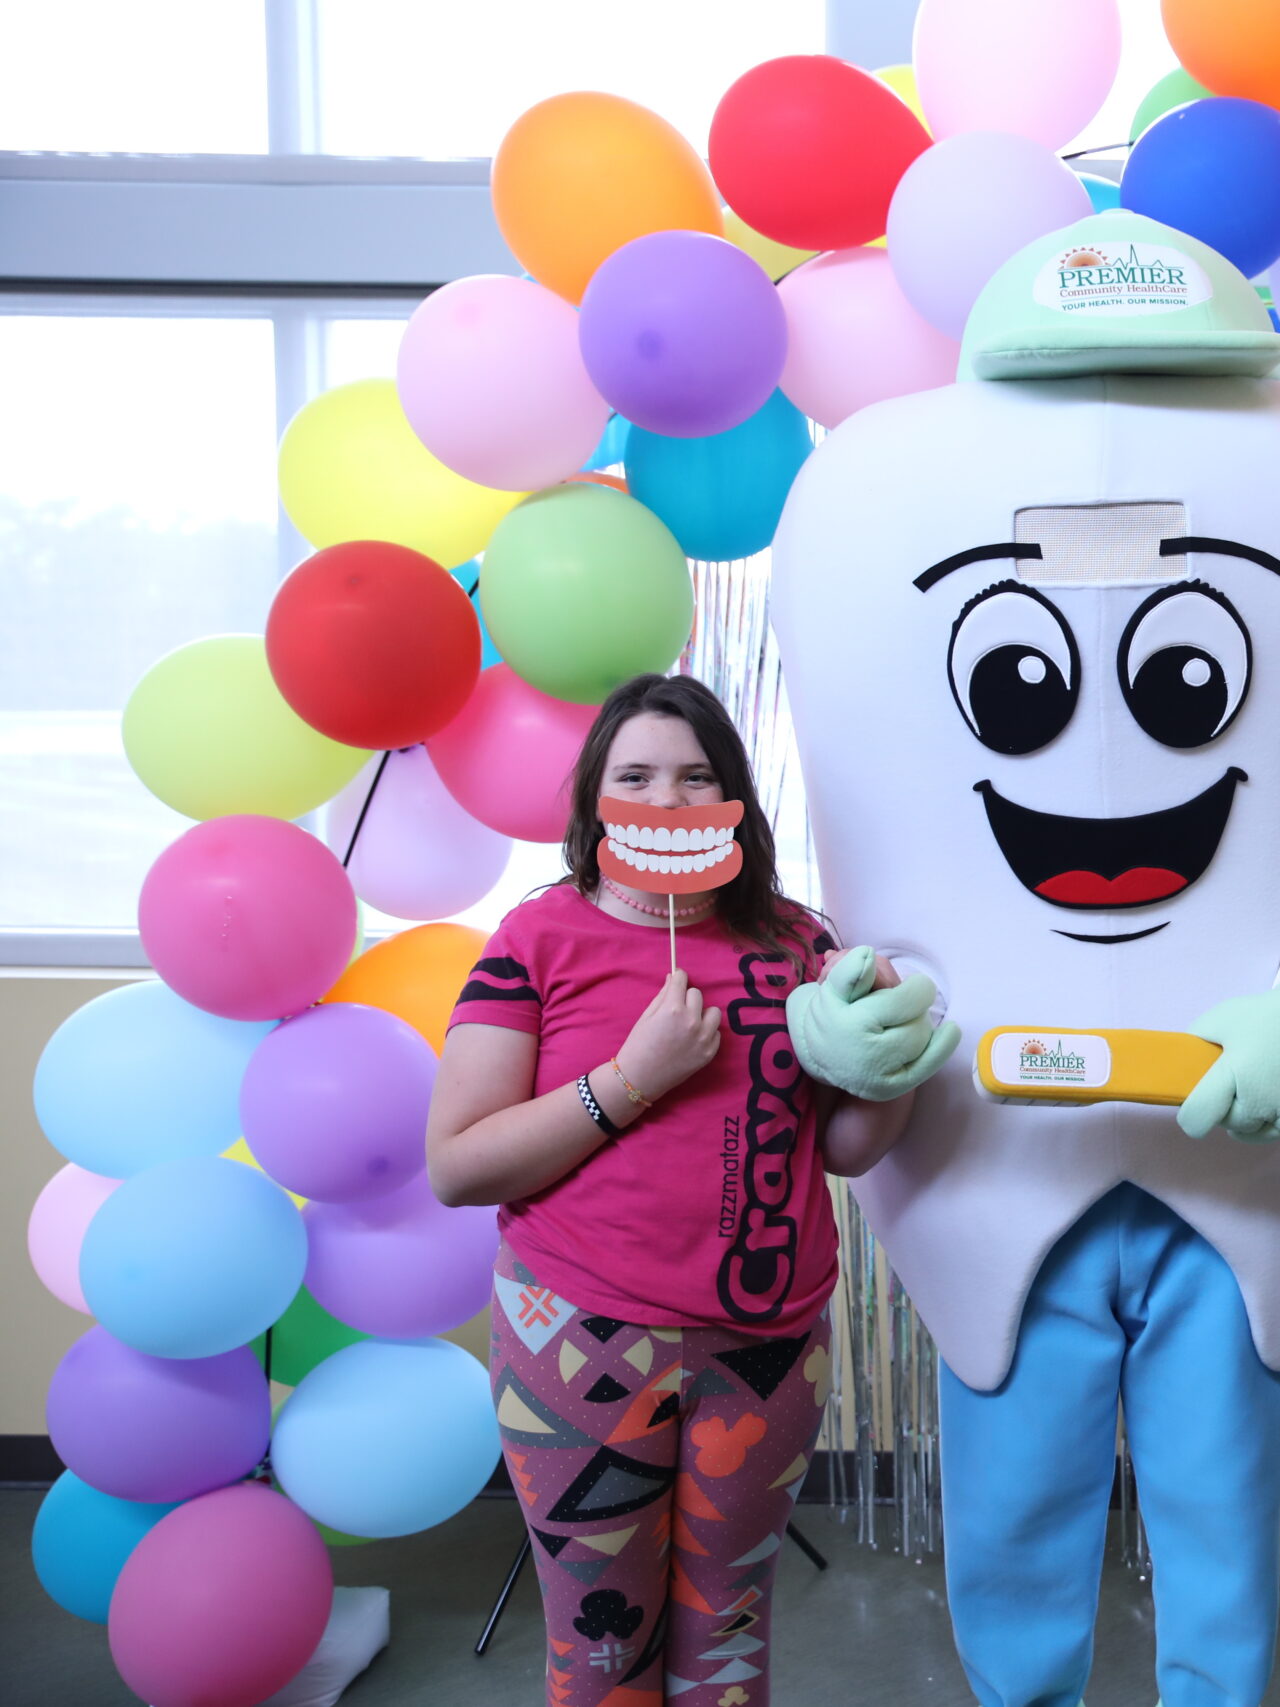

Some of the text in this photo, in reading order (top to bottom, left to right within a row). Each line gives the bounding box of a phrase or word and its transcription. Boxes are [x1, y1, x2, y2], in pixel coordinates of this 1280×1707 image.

[1059, 267, 1187, 288] PREMIER
[1060, 284, 1188, 298] Community HealthCare
[1062, 302, 1086, 311] YOUR
[1088, 299, 1125, 308] HEALTH.
[1149, 298, 1188, 306] MISSION.
[1019, 1055, 1085, 1069] PREMIER
[717, 952, 806, 1323] Crayola
[718, 1115, 740, 1238] razzmatazz
